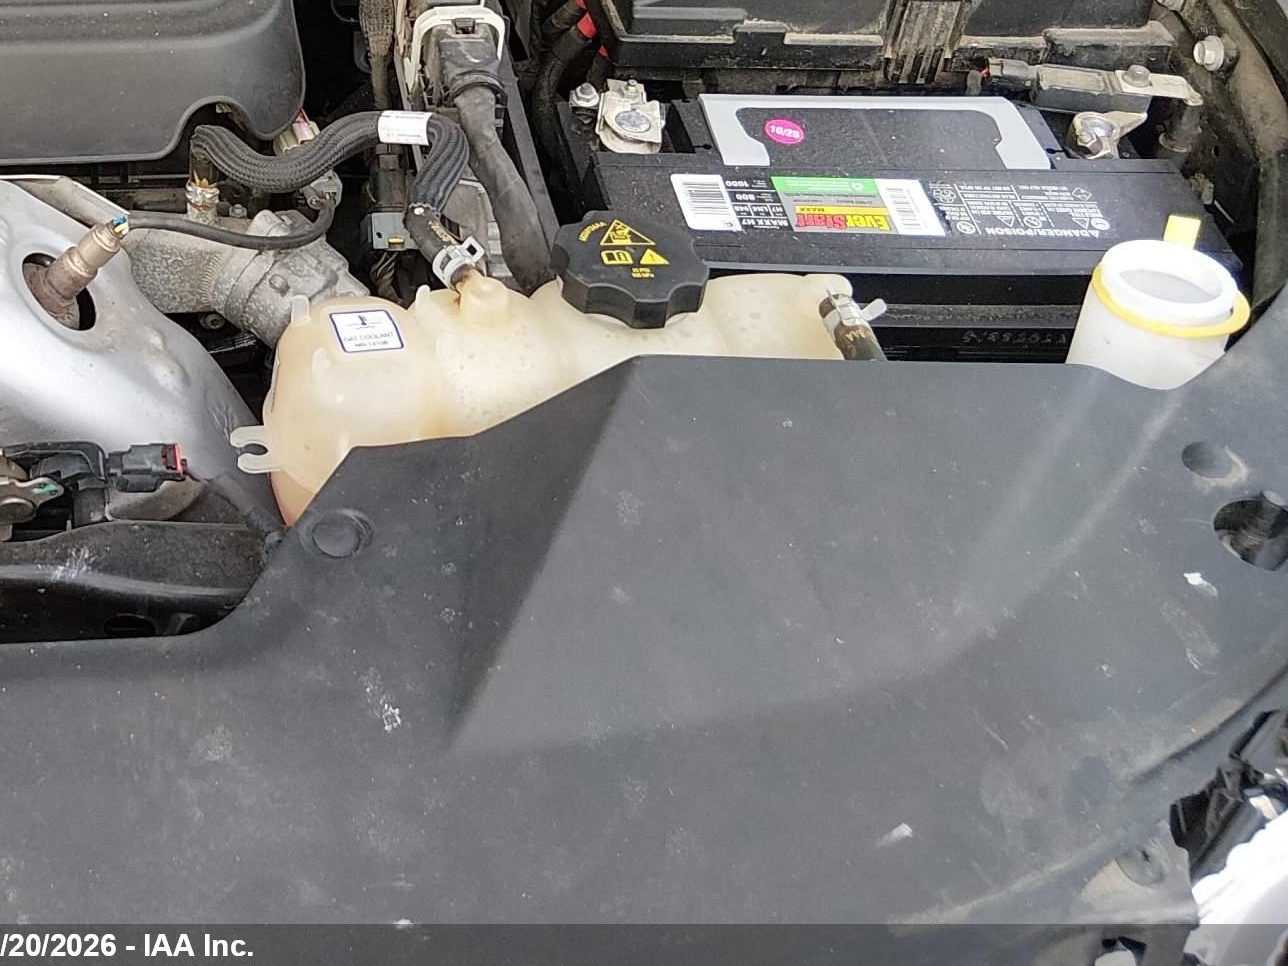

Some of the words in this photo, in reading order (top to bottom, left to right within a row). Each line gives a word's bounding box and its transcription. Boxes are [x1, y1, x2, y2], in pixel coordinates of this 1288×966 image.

[735, 193, 756, 201] 800
[756, 218, 789, 227] MAXX
[795, 214, 891, 231] EverStart
